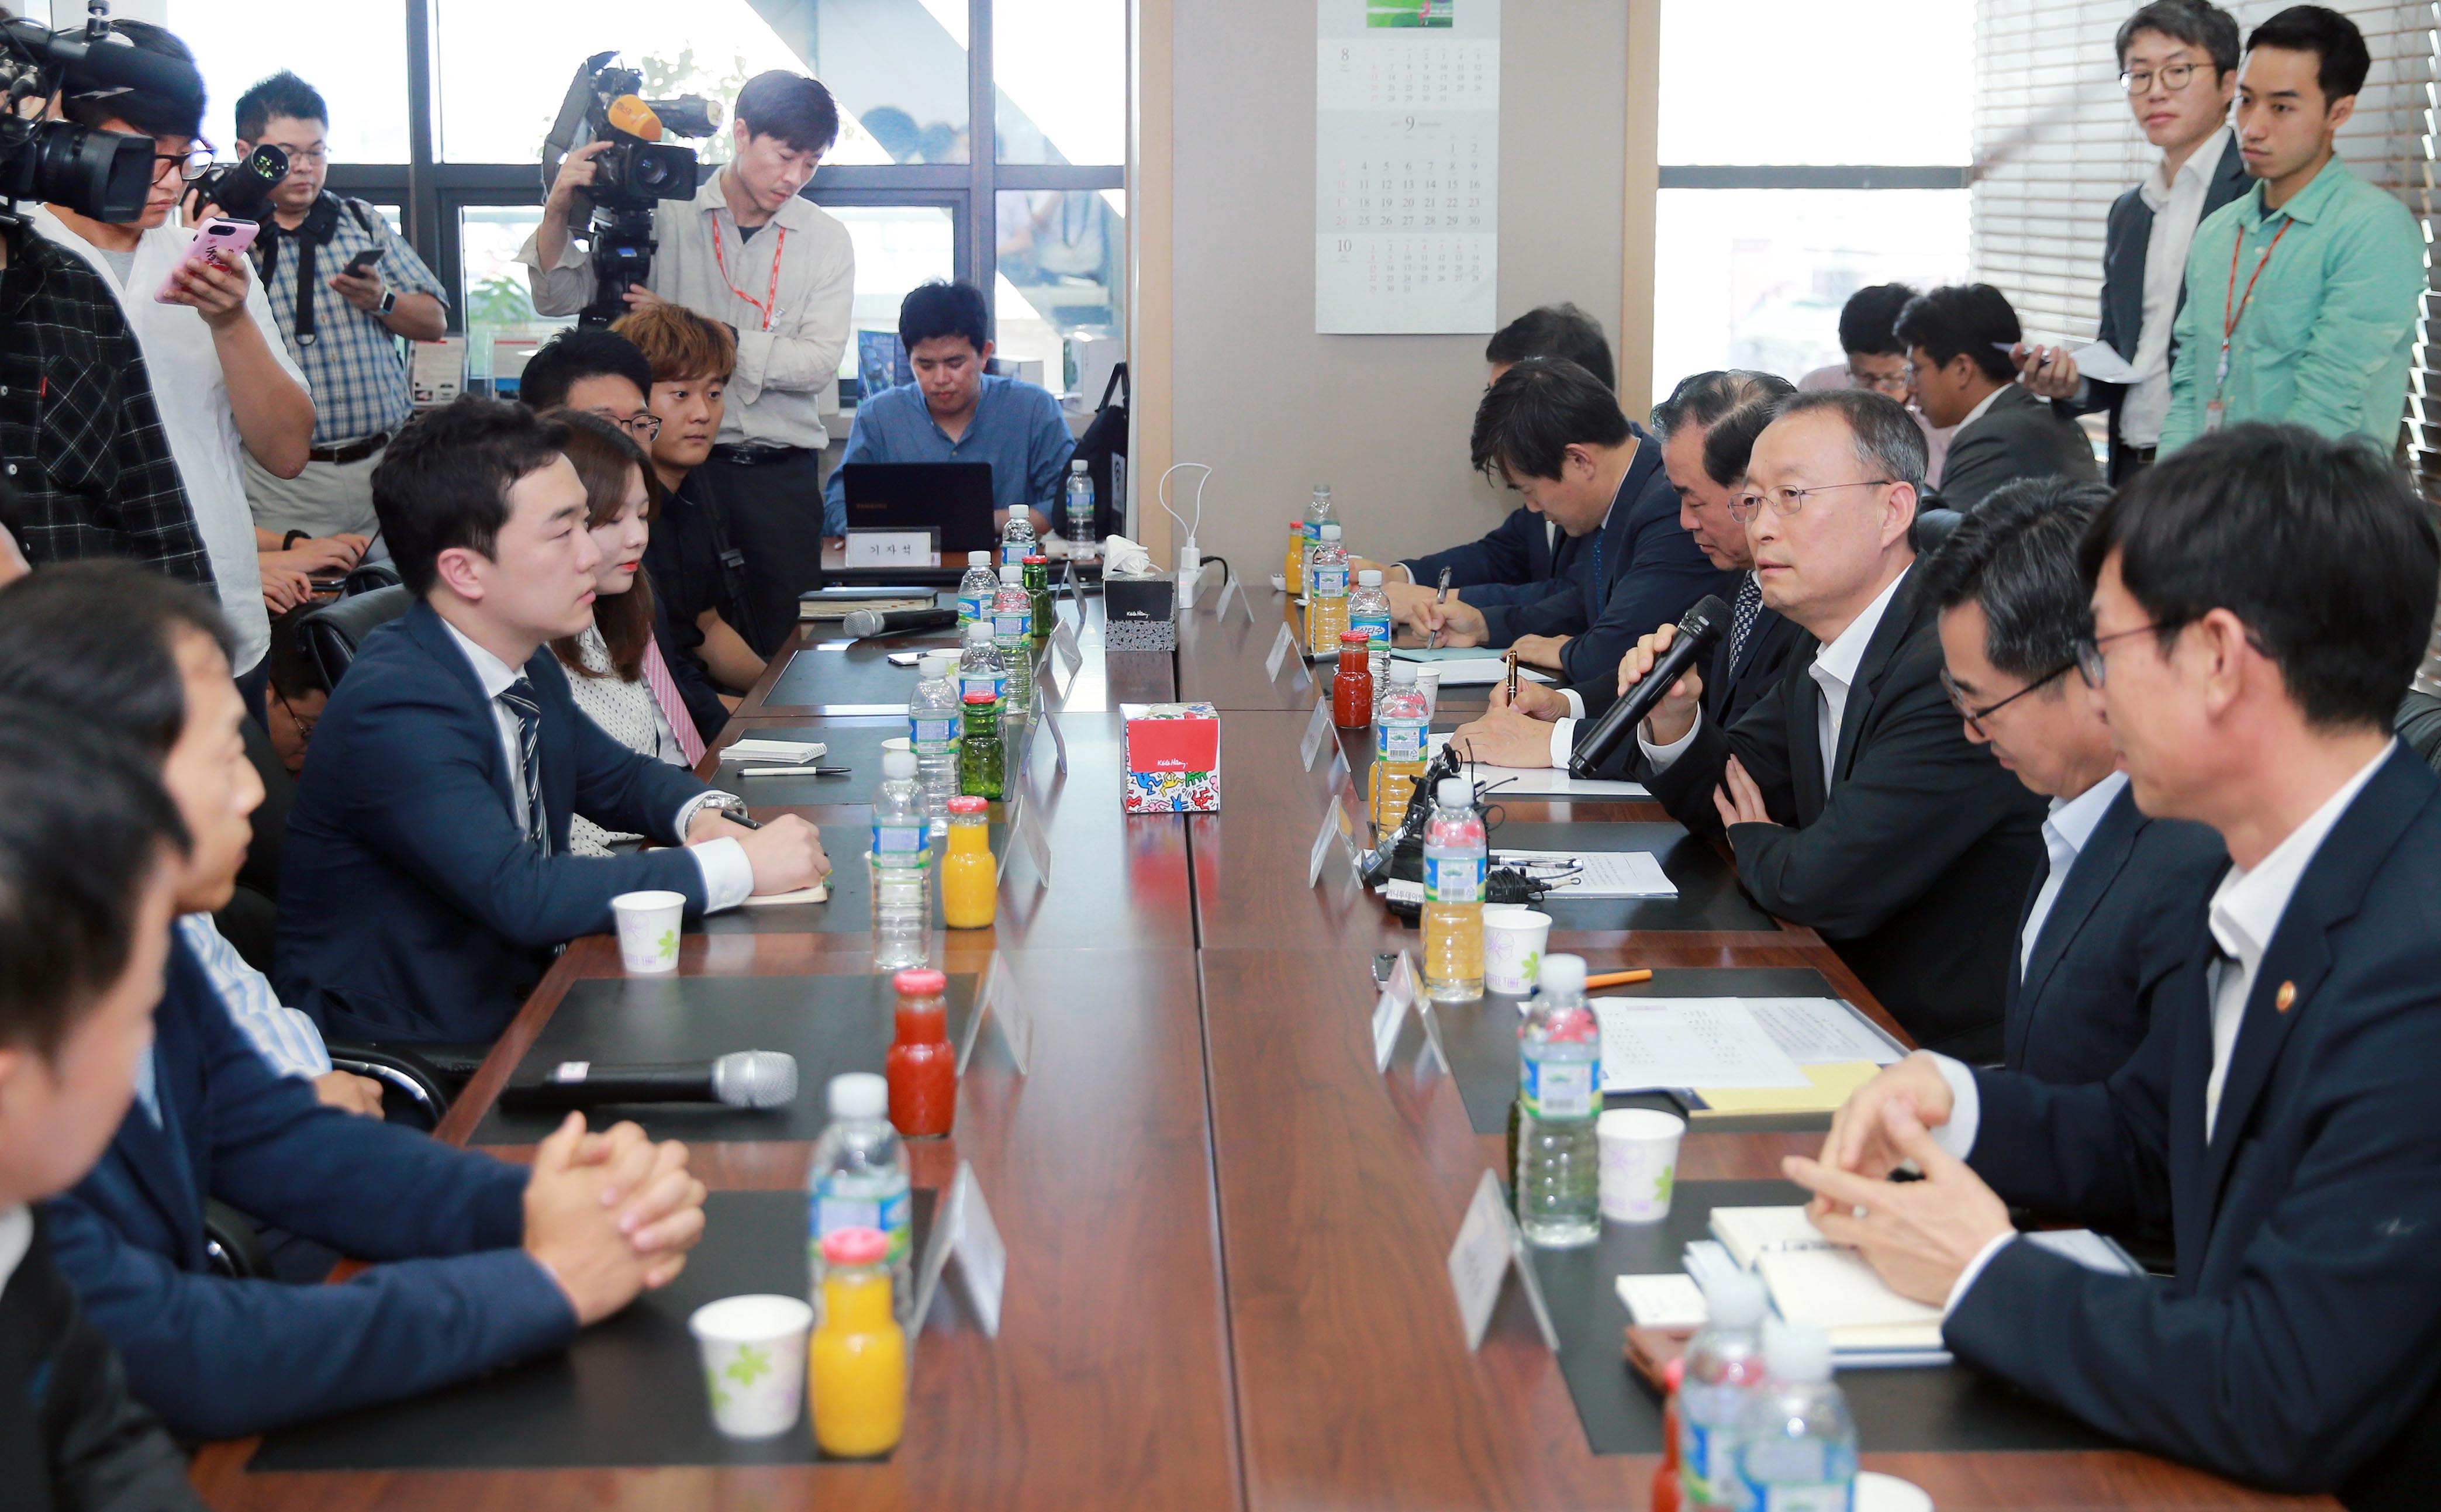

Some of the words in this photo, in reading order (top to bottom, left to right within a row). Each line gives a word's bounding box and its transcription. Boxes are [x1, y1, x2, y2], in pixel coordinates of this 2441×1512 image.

[1341, 47, 1349, 61] 8
[1405, 116, 1415, 131] 9
[1451, 144, 1455, 153] 1
[1472, 144, 1477, 153] 2
[1362, 161, 1367, 171] 4
[1384, 161, 1389, 171] 5
[1406, 161, 1411, 171] 6
[1428, 161, 1434, 171] 7
[1472, 161, 1477, 171] 9
[1359, 180, 1369, 189] 11
[1382, 180, 1392, 189] 12
[1404, 180, 1414, 189] 13
[1425, 180, 1436, 189] 14
[1448, 180, 1458, 189] 15
[1469, 180, 1480, 189] 16
[1359, 198, 1370, 208] 18
[1382, 198, 1392, 208] 19
[1403, 198, 1414, 208] 20
[1425, 198, 1435, 208] 21
[1446, 198, 1458, 208] 22
[1469, 198, 1479, 208] 23
[1359, 216, 1370, 226] 25
[1380, 216, 1392, 226] 26
[1403, 216, 1414, 226] 27
[1424, 216, 1436, 226] 28
[1446, 216, 1458, 226] 29
[1469, 216, 1480, 226] 30
[1337, 239, 1352, 252] 10
